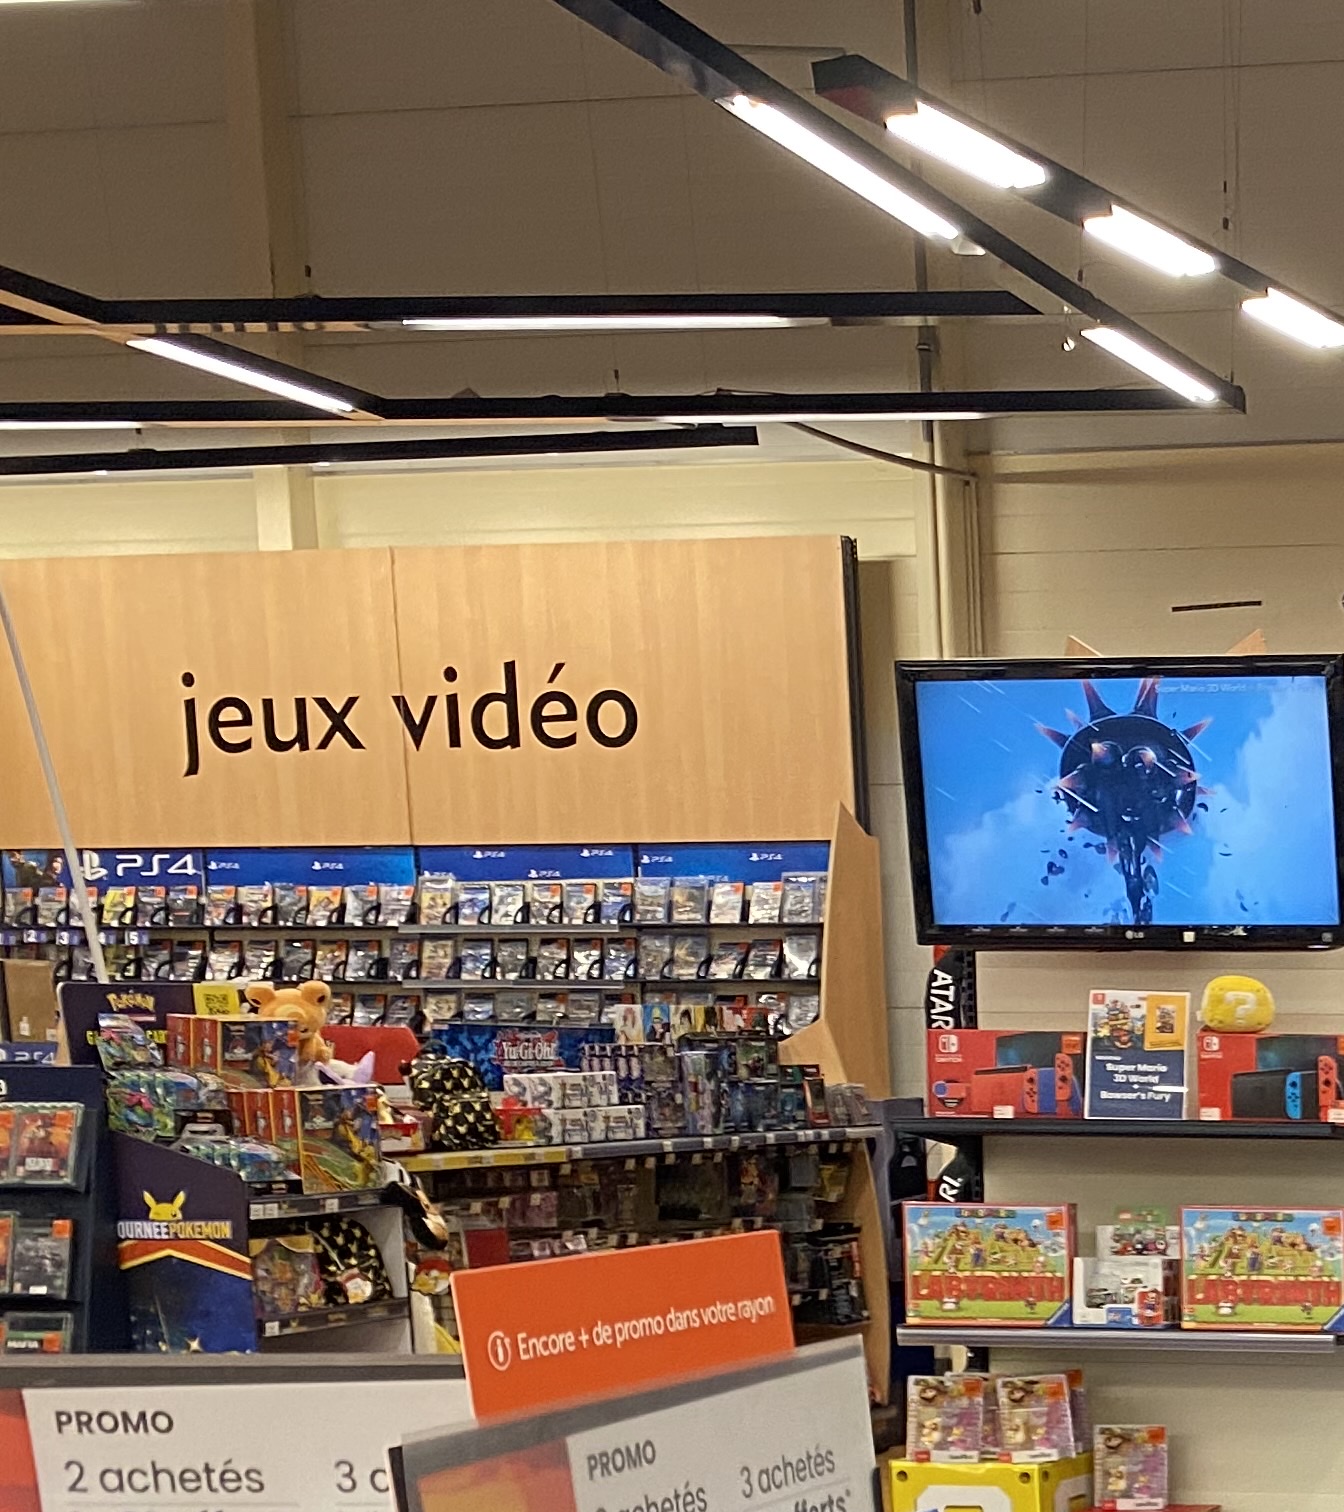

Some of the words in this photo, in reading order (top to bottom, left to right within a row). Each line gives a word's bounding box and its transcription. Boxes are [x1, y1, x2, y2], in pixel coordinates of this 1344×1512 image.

[181, 672, 366, 776] jeux
[392, 662, 639, 752] vidéo
[116, 853, 201, 876] PS4
[518, 1327, 576, 1360] Encore
[593, 1321, 613, 1345] de
[614, 1315, 664, 1348] promo
[666, 1306, 699, 1333] dans
[701, 1304, 736, 1327] votre
[738, 1296, 775, 1327] rayon
[55, 1411, 174, 1435] PROMO
[64, 1460, 89, 1494] 2
[98, 1459, 266, 1494] achetés
[334, 1460, 357, 1494] 3
[587, 1440, 656, 1481] PROMO
[740, 1466, 754, 1498] 3
[758, 1445, 836, 1493] achetés
